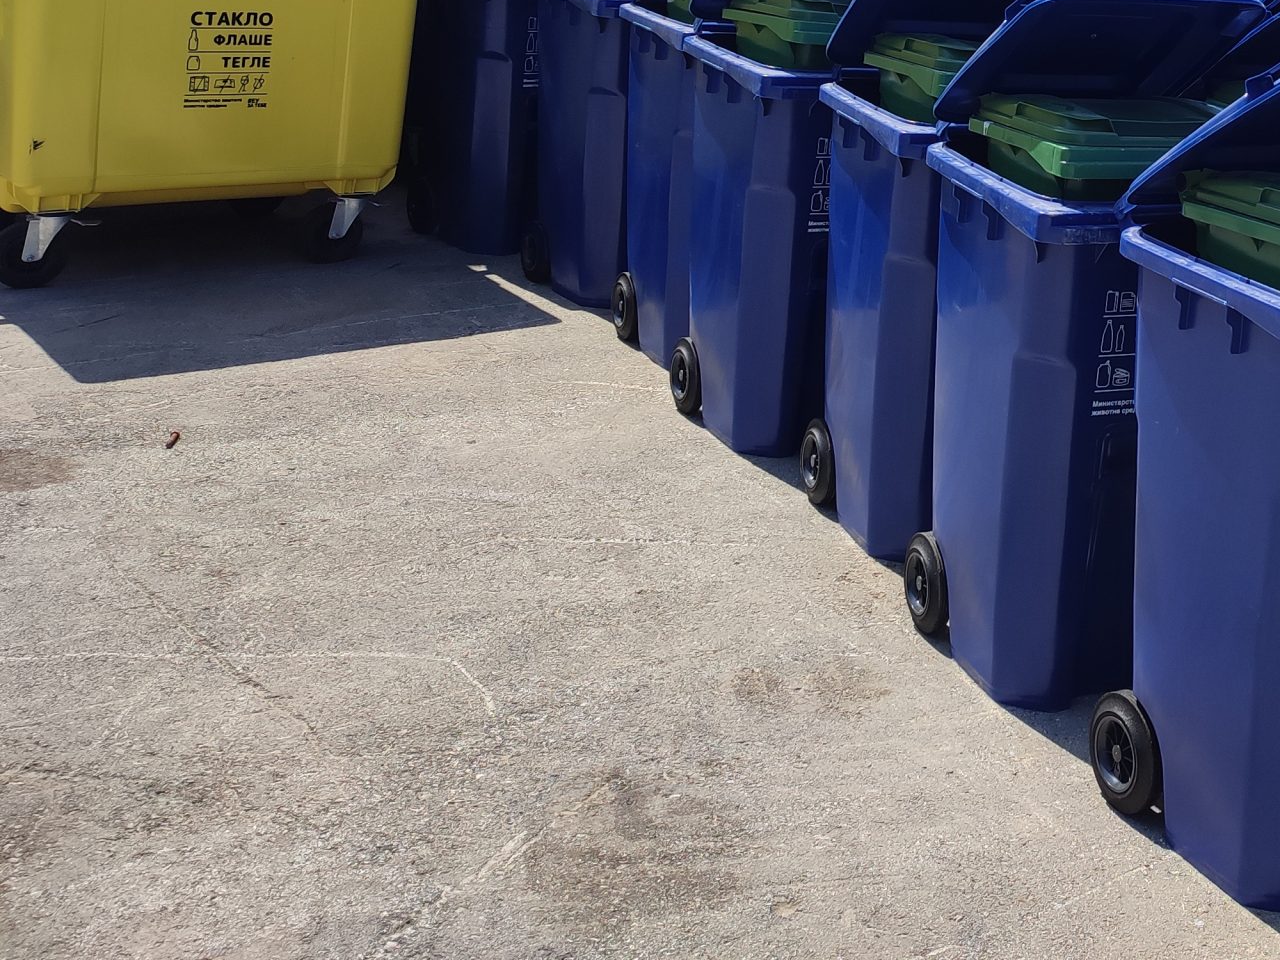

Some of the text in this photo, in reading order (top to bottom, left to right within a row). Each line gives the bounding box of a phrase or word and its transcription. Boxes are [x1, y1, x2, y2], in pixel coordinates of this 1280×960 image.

[190, 11, 274, 27] СТАКЛО
[213, 34, 273, 46] ФЛАШЕ
[222, 56, 271, 68] ТЕГЛЕ
